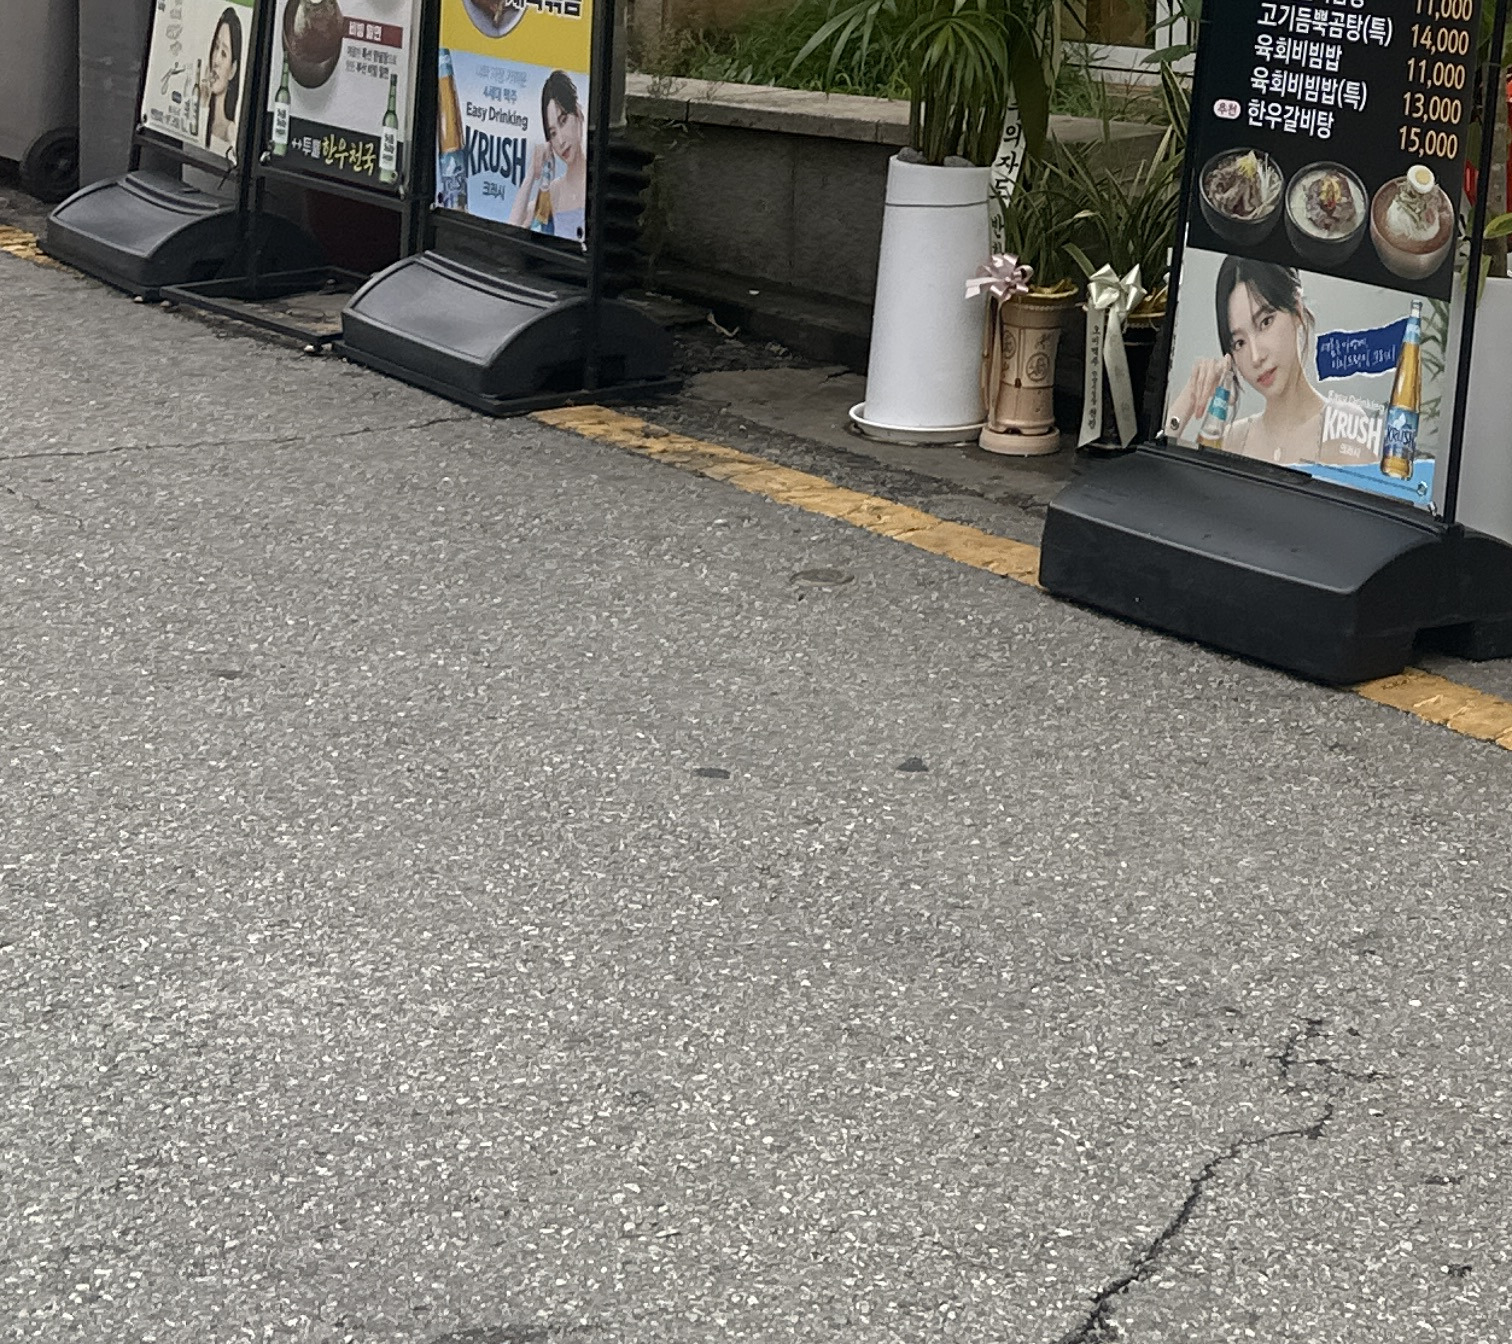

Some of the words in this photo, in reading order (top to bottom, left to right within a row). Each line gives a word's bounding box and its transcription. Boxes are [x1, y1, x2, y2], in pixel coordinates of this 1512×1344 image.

[1257, 3, 1393, 46] 고기듬뿍곰탕(특)
[1411, 24, 1469, 55] 14,000
[1254, 35, 1342, 71] 육회비빔밥
[1407, 58, 1465, 90] 11,000
[466, 102, 487, 123] Easy
[489, 107, 529, 132] Drinking
[1250, 67, 1367, 111] 육회비빔밥(특)
[1402, 91, 1461, 124] 13,000
[466, 125, 527, 187] KRUSH
[1247, 99, 1334, 139] 한우갈비탕
[1399, 126, 1457, 159] 15,000
[1322, 406, 1383, 458] KRUSH
